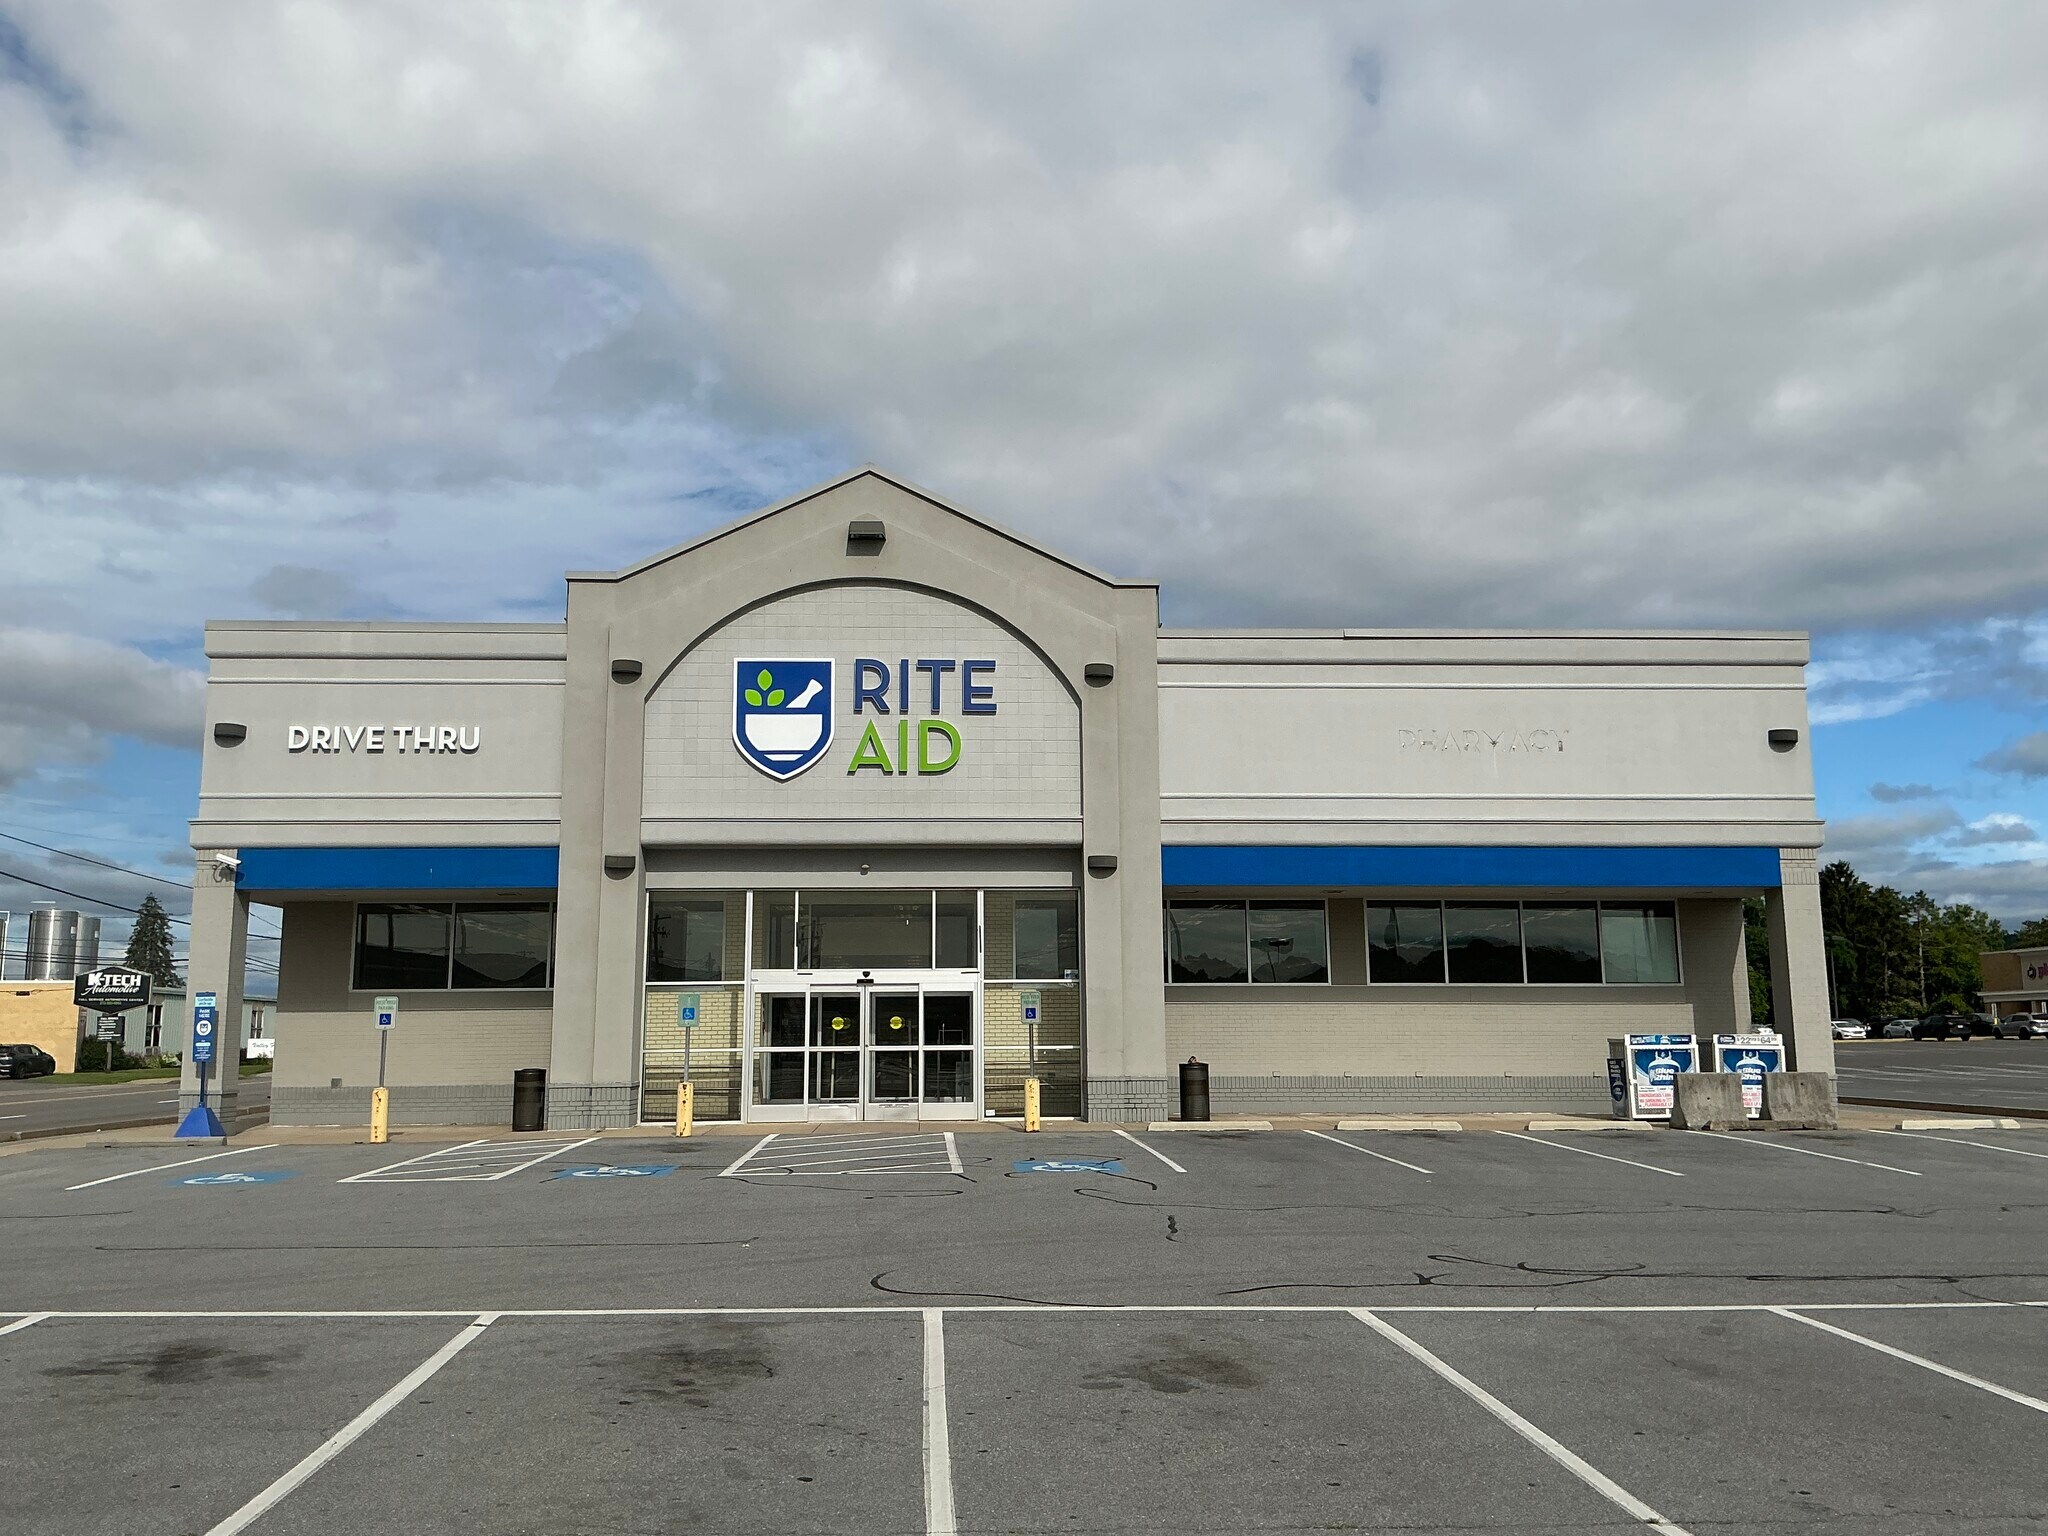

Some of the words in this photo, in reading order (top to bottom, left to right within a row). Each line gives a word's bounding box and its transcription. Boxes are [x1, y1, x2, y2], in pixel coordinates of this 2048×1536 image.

[853, 658, 997, 715] RITE
[288, 725, 385, 753] DRIVE
[393, 725, 481, 754] THRU
[847, 719, 962, 775] AID
[80, 984, 140, 996] Automotive
[87, 972, 142, 987] K-TECH
